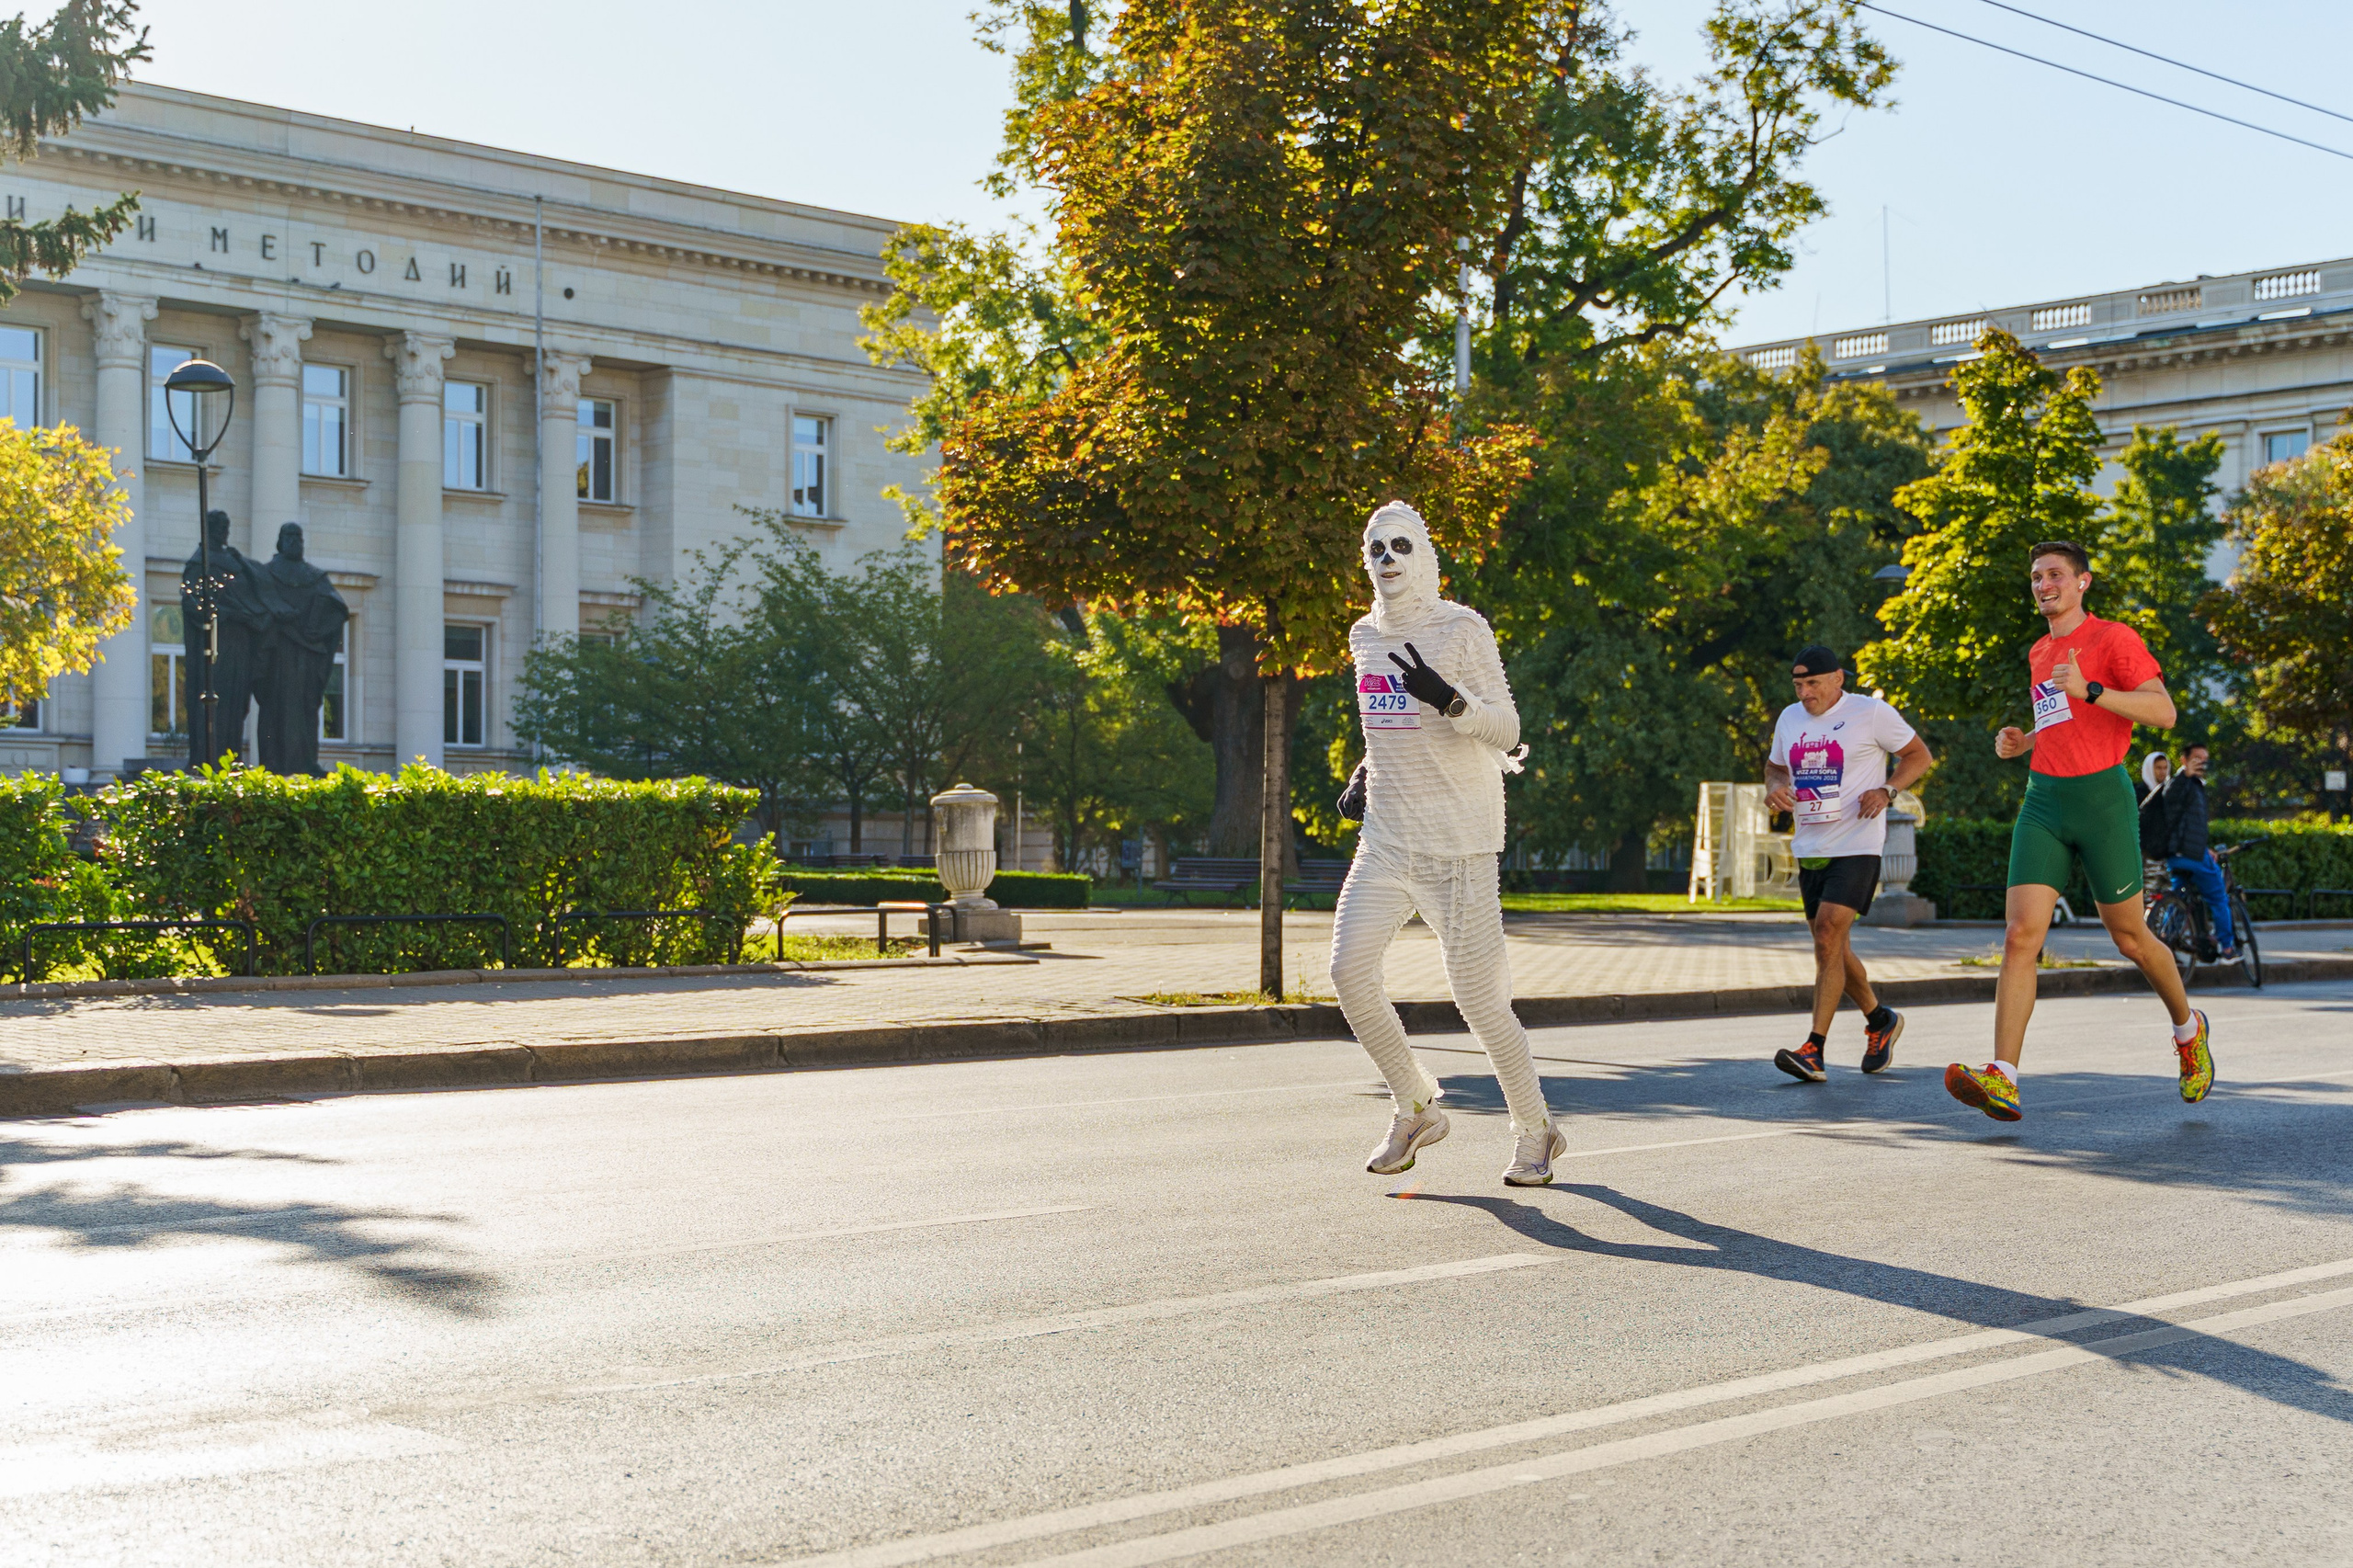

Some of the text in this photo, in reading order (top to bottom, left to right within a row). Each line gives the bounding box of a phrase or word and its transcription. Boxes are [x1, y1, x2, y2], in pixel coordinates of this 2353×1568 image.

[137, 215, 156, 242] И
[210, 227, 512, 295] МЕТОДИЙ
[1369, 695, 1407, 710] 2479
[2036, 697, 2057, 715] 360
[1809, 801, 1823, 812] 27
